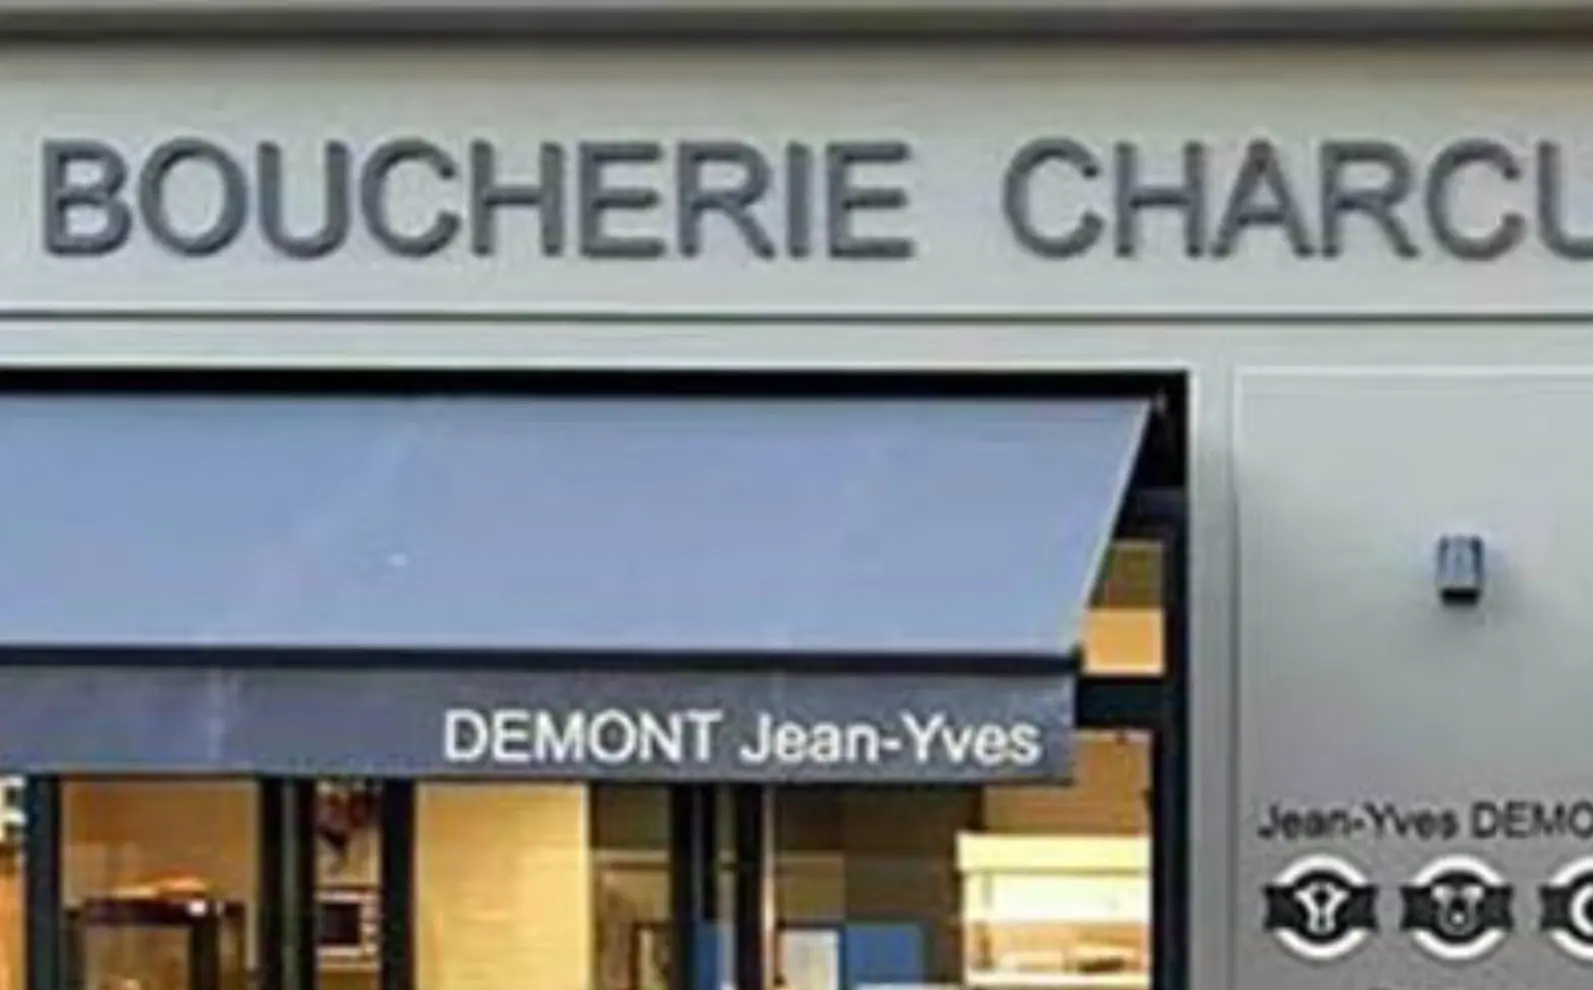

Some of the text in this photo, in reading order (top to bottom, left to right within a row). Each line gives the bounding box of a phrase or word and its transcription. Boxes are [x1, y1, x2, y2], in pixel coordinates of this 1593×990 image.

[40, 138, 918, 260] BOUCHERIE
[442, 708, 1042, 766] DEMONT Jean-Yves
[1257, 803, 1459, 840] Jean-Yves
